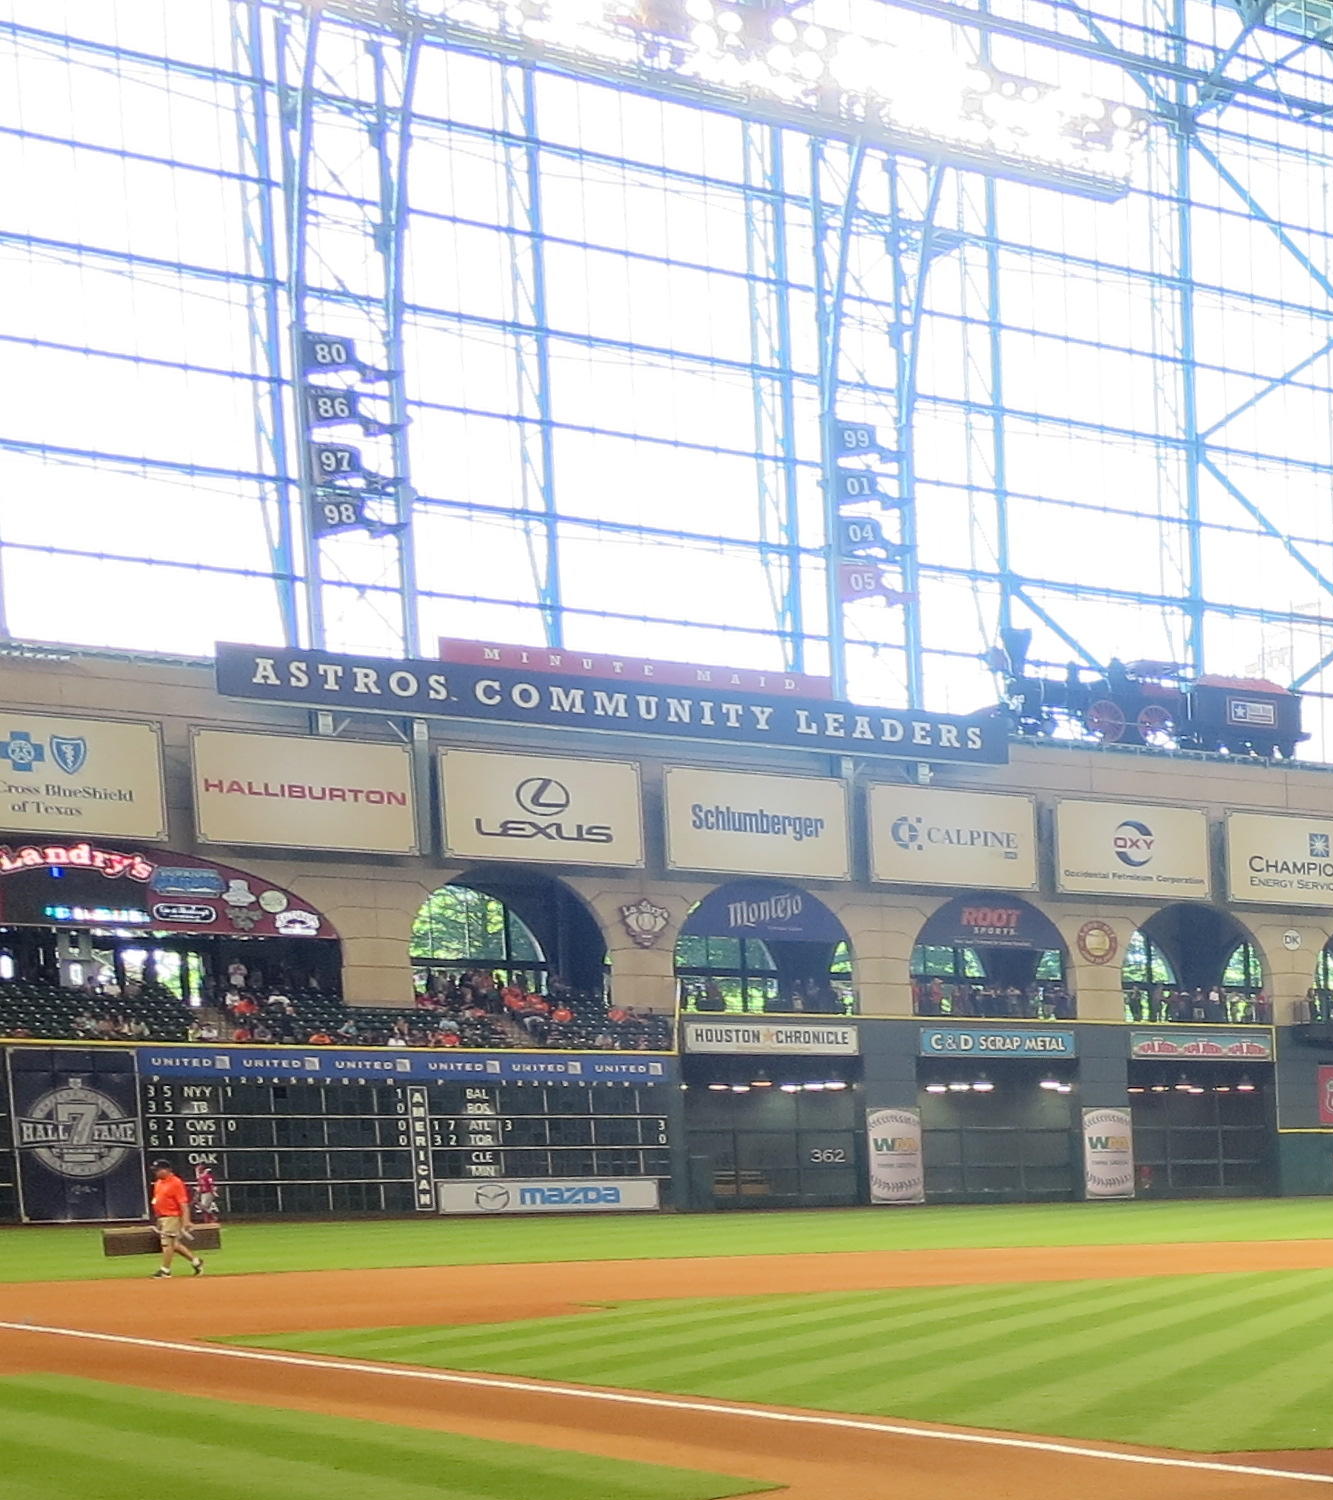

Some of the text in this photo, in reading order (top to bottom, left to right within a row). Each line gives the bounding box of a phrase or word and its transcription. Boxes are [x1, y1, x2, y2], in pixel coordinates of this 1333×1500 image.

[315, 343, 347, 364] 80
[318, 398, 349, 417] 86
[843, 430, 869, 448] 99
[320, 451, 350, 471] 97
[846, 477, 871, 495] 01
[324, 504, 356, 524] 98
[849, 524, 875, 542] 04
[850, 573, 876, 591] 05
[483, 646, 796, 691] MINUTE MAID
[252, 656, 983, 750] ASTROS COMMUNITY LEADERS
[45, 783, 134, 802] BlueShield
[203, 777, 407, 808] HALLIBURTON
[11, 800, 83, 817] of Texas
[474, 818, 613, 844] LEXUS
[691, 803, 825, 842] Schlumberger
[927, 826, 1017, 849] CALPINE
[1113, 835, 1155, 850] OXY
[0, 843, 153, 879] Landry's
[728, 892, 803, 928] Montejo
[961, 907, 1021, 927] ROOT
[973, 926, 1016, 936] SPORTS
[695, 1028, 849, 1045] HOUSTON CHRONICLE
[930, 1034, 1065, 1051] C & D SCRAP METAL
[183, 1086, 212, 1098] NYY
[21, 1122, 68, 1143] HALL
[93, 1122, 136, 1142] FAME
[185, 1120, 216, 1131] CWS
[189, 1134, 214, 1146] DET
[188, 1152, 218, 1165] OAK
[810, 1148, 846, 1162] 362
[520, 1186, 621, 1205] mazda
